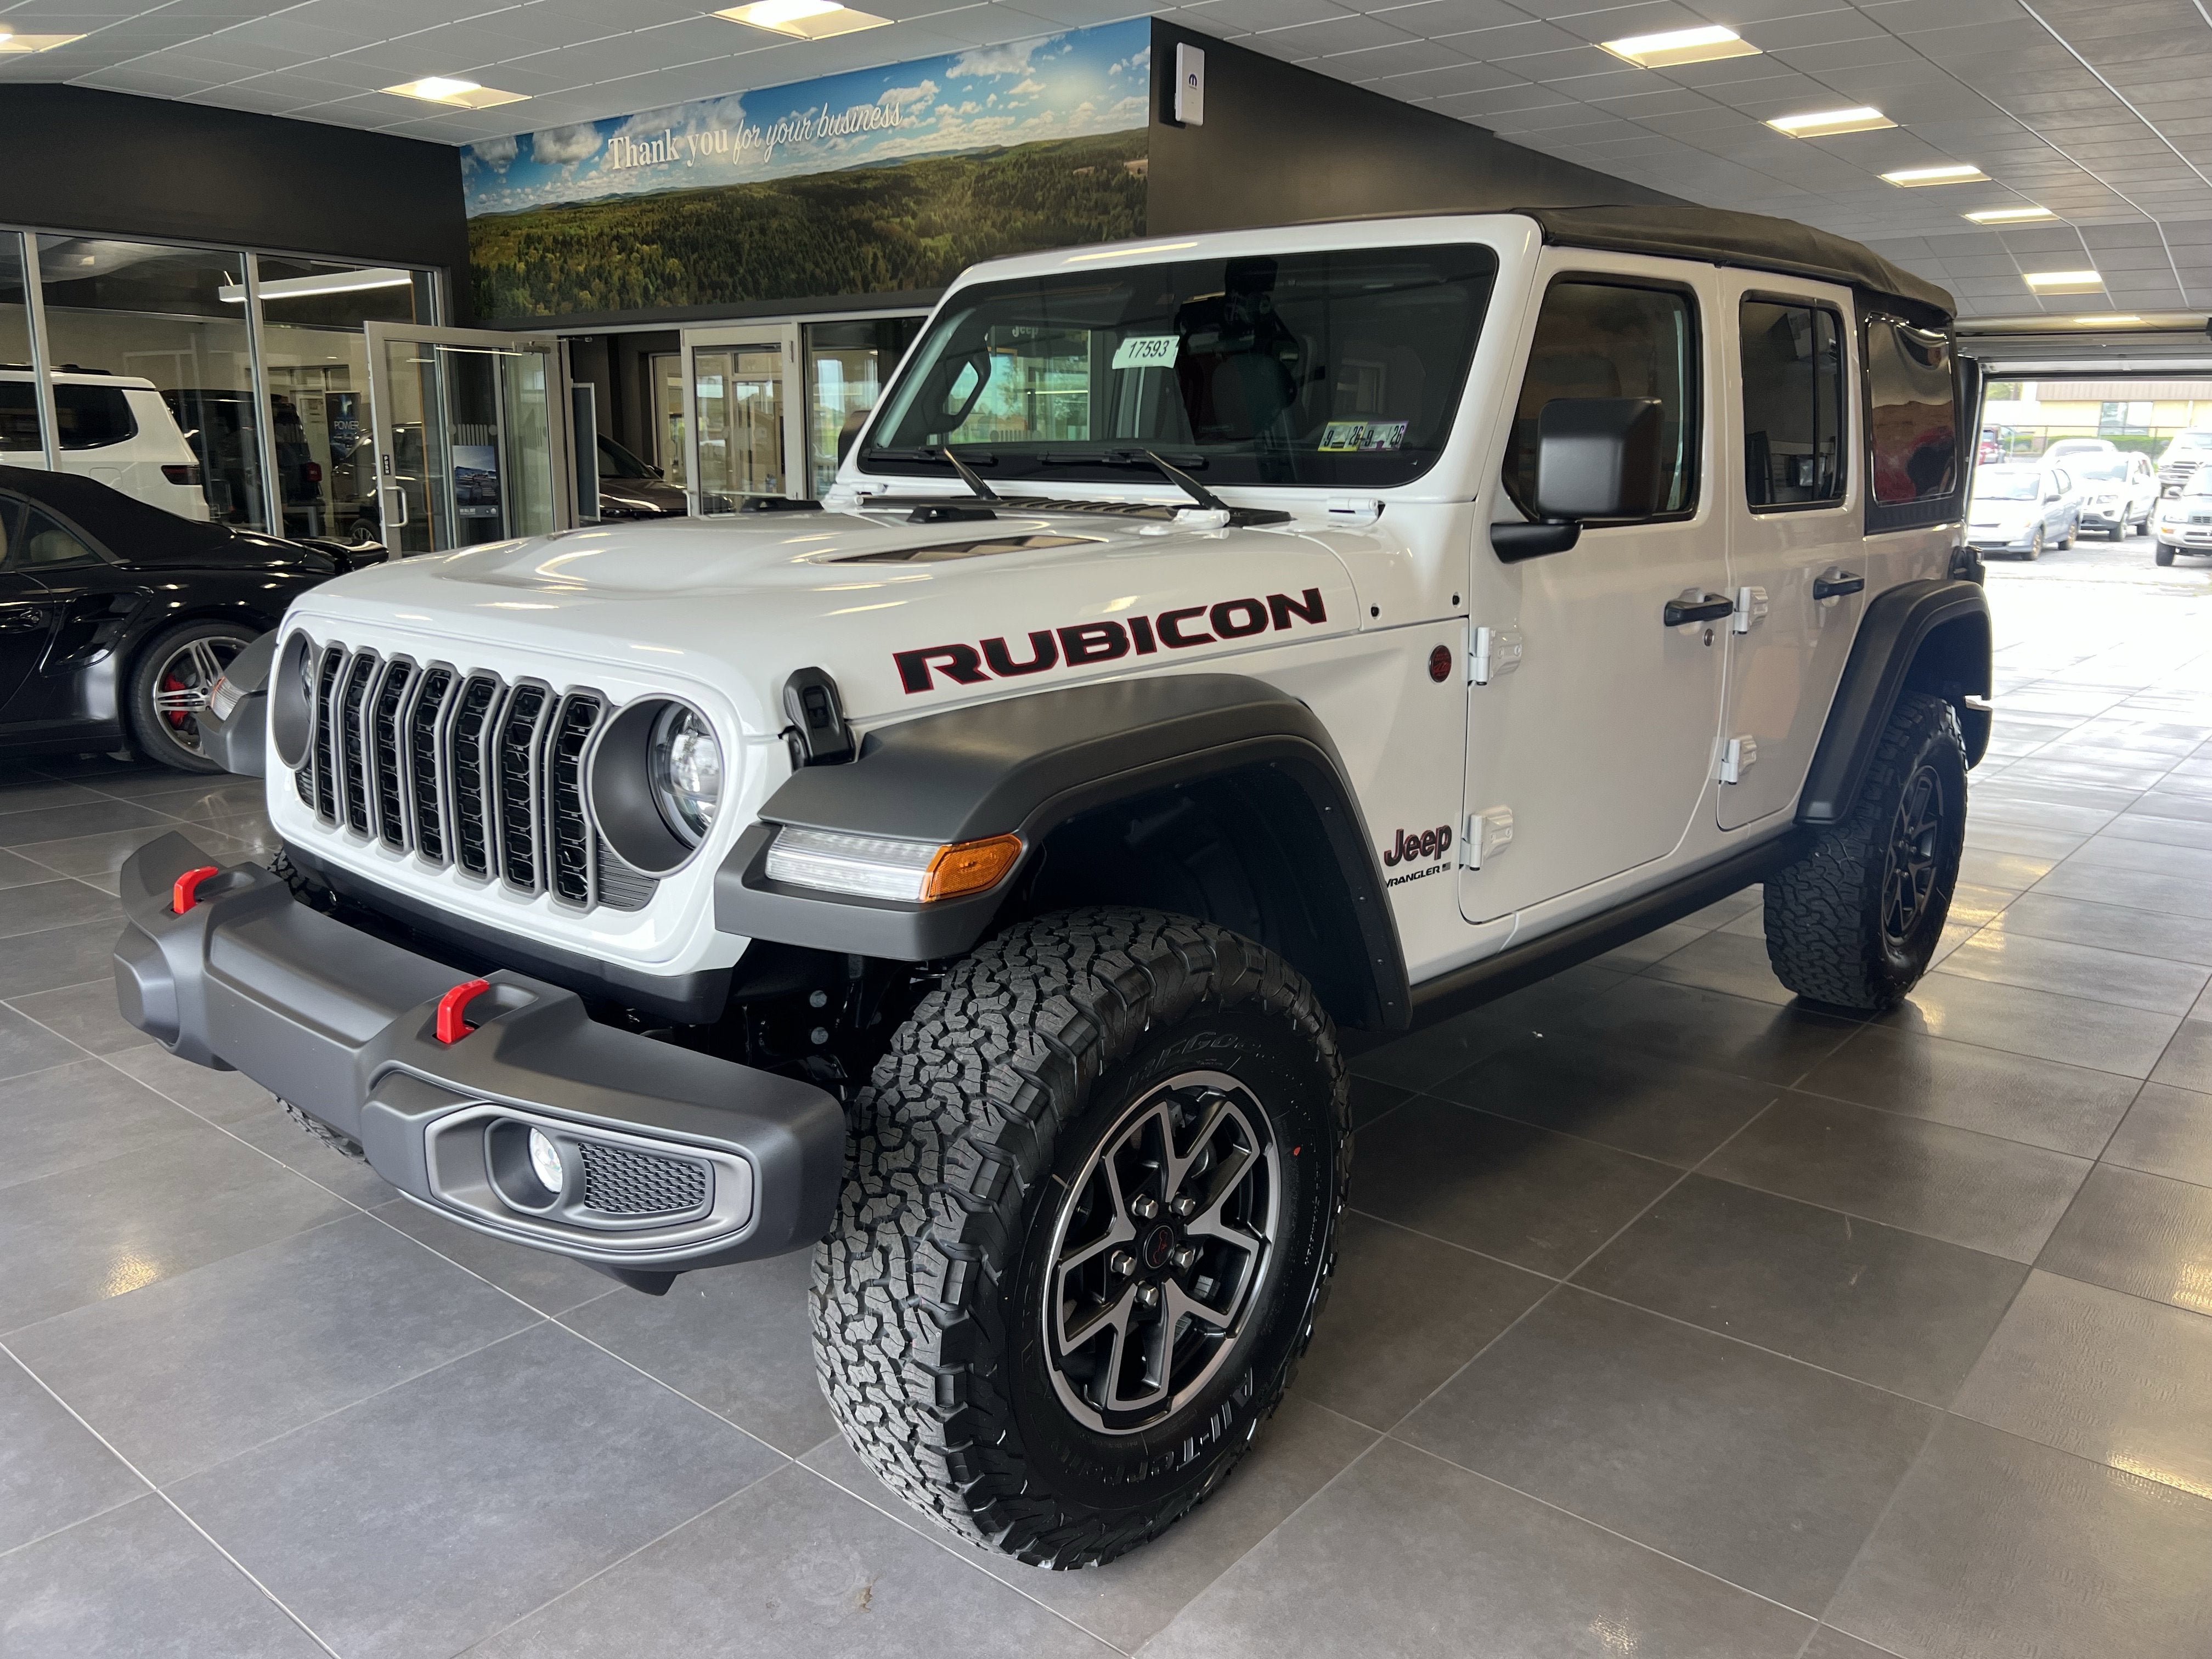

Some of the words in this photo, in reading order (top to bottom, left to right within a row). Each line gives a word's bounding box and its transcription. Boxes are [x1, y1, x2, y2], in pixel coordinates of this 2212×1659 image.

[607, 128, 680, 170] Thank
[687, 127, 729, 167] you
[732, 118, 761, 165] for
[764, 117, 813, 163] your
[818, 101, 903, 139] business
[1128, 340, 1170, 359] 17593
[334, 420, 360, 430] POWER
[1364, 430, 1374, 447] 9
[1389, 425, 1405, 448] 26
[1324, 430, 1334, 447] 9
[892, 587, 1328, 695] RUBICON
[1384, 825, 1452, 867] Jeep
